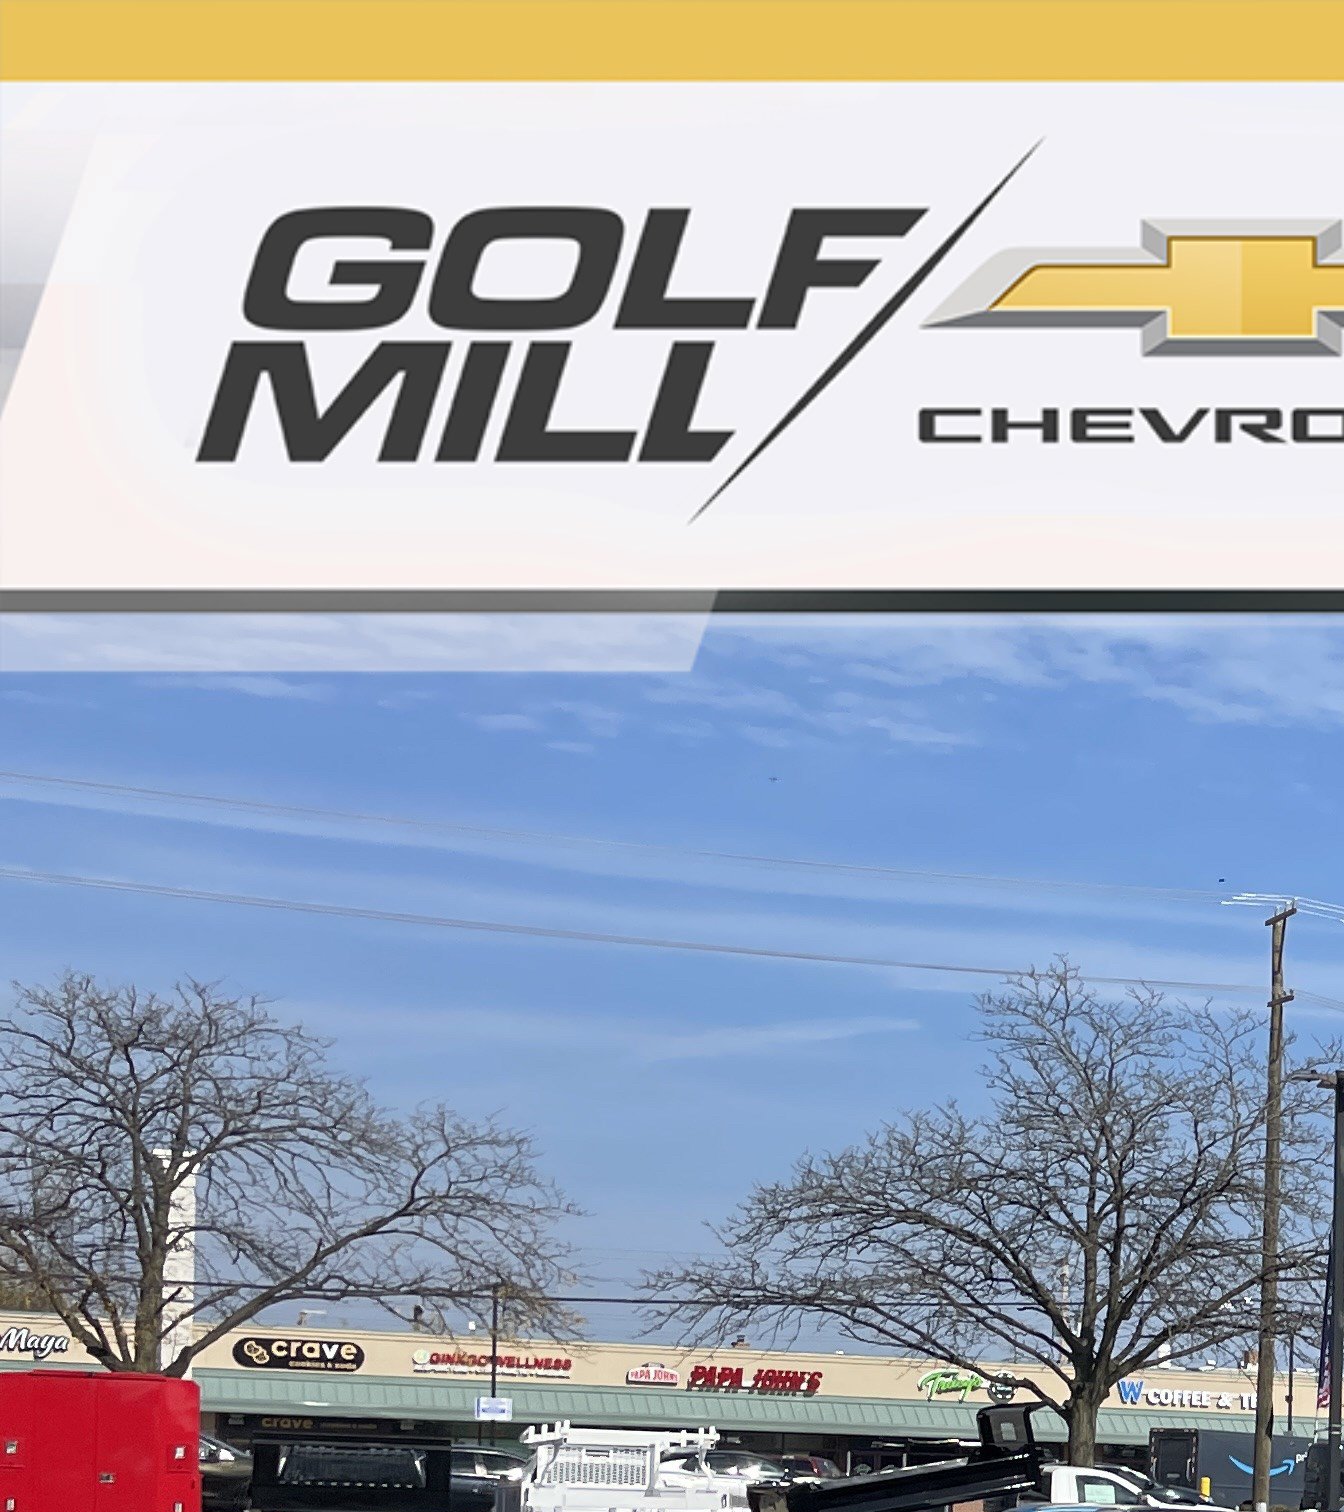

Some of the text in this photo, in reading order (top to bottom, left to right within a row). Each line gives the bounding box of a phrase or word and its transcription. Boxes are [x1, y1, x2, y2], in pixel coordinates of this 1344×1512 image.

[271, 1340, 357, 1360] crave
[688, 1365, 743, 1389] PAPA
[1119, 1380, 1257, 1409] W COFFEE & TE
[261, 1417, 313, 1429] crave
